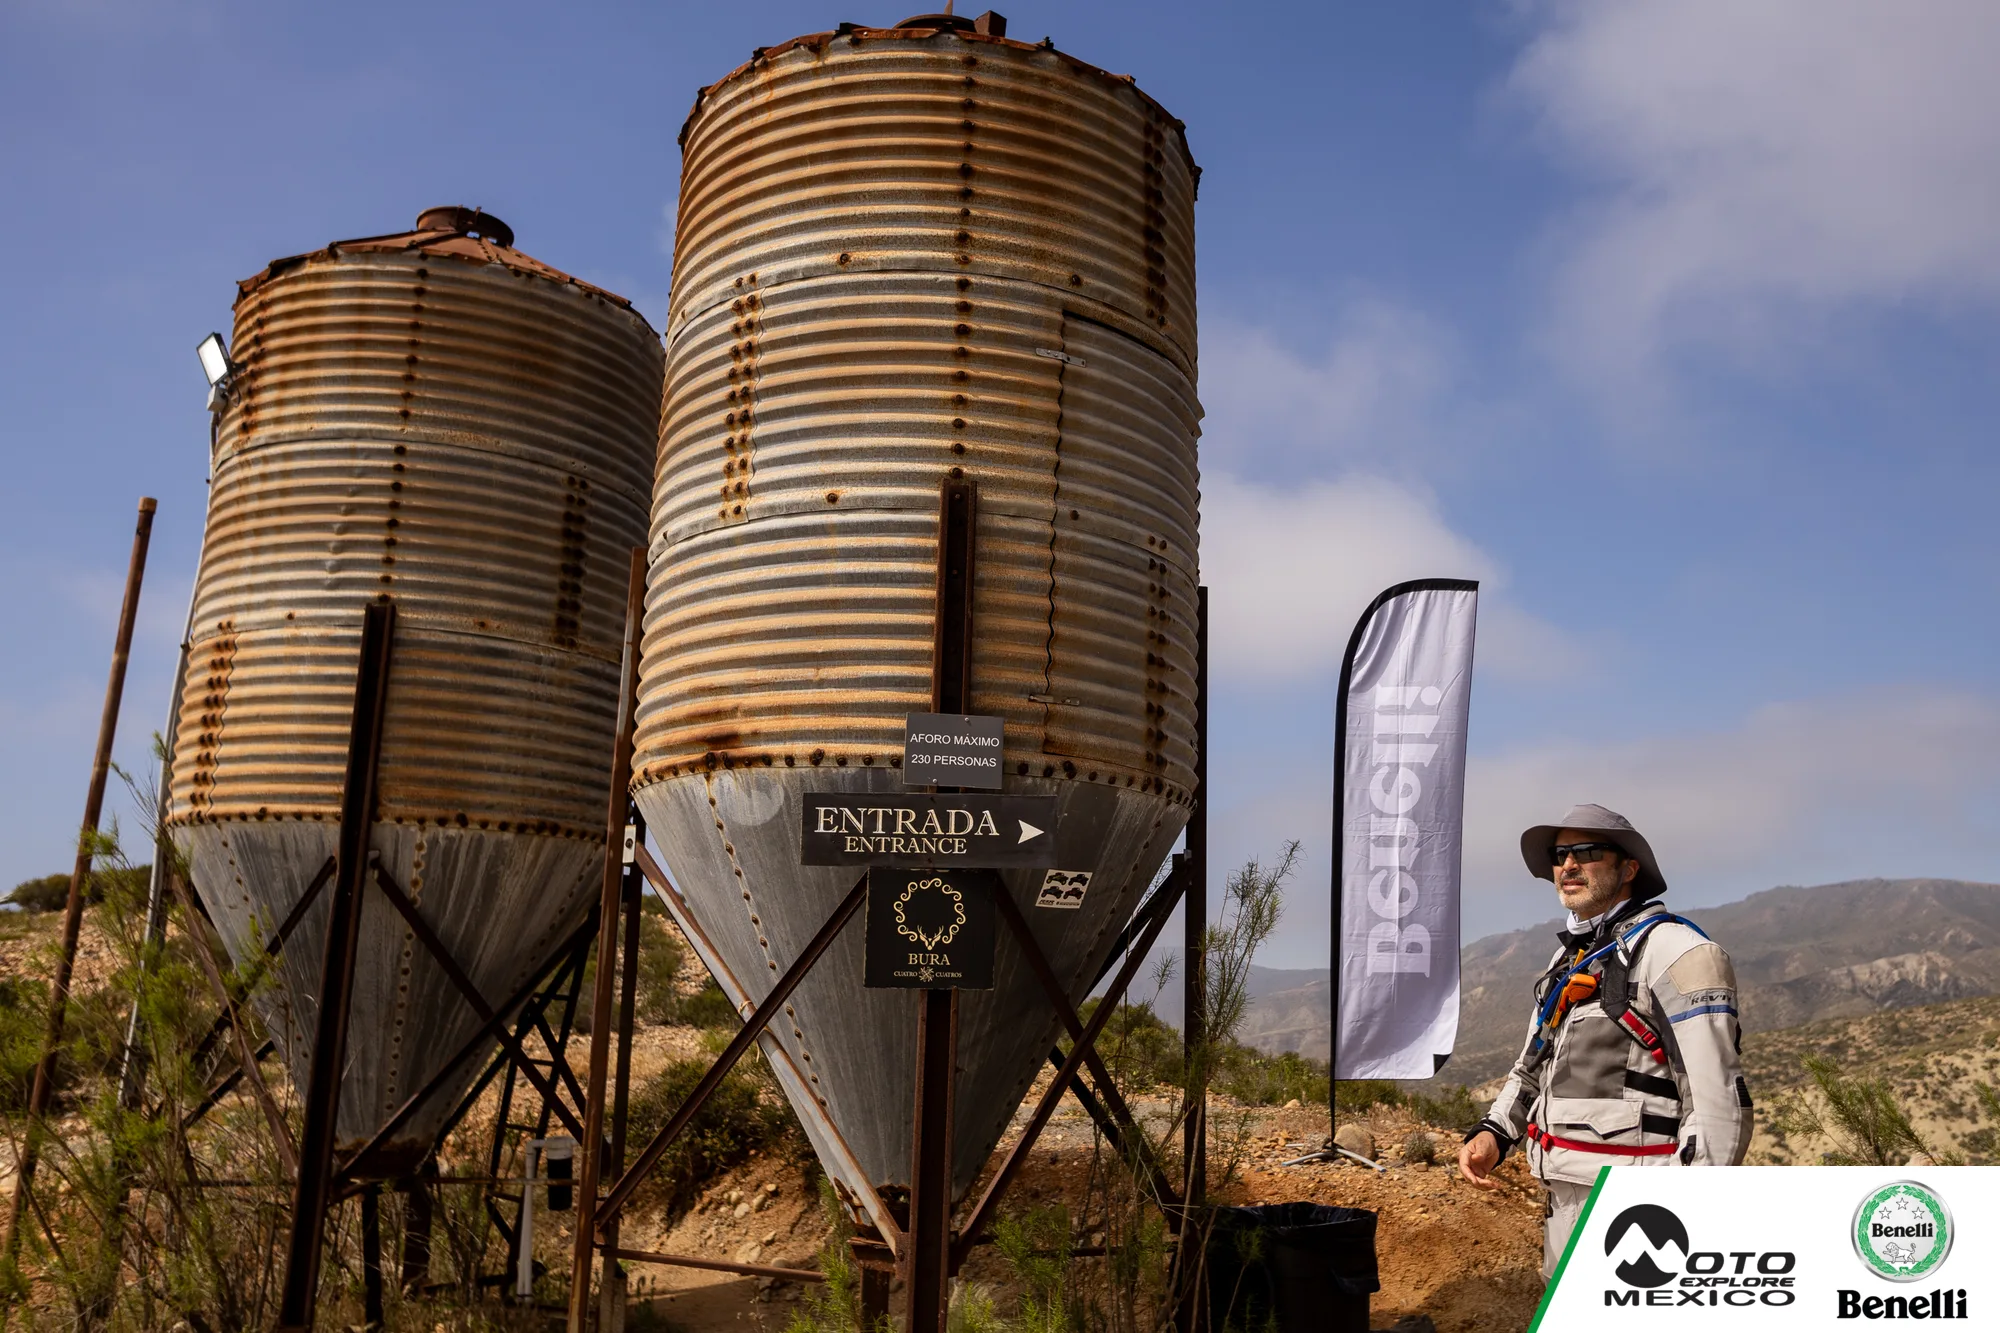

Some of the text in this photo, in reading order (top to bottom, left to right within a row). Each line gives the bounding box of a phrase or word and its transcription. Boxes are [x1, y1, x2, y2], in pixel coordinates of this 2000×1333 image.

[909, 732, 1000, 748] AFORO MÁXIMO
[911, 753, 997, 768] 230 PERSONAS
[814, 806, 1000, 836] ENTRADA
[844, 836, 967, 854] ENTRANCE
[907, 953, 951, 966] BURA
[893, 970, 963, 979] CUATRO CUATROS
